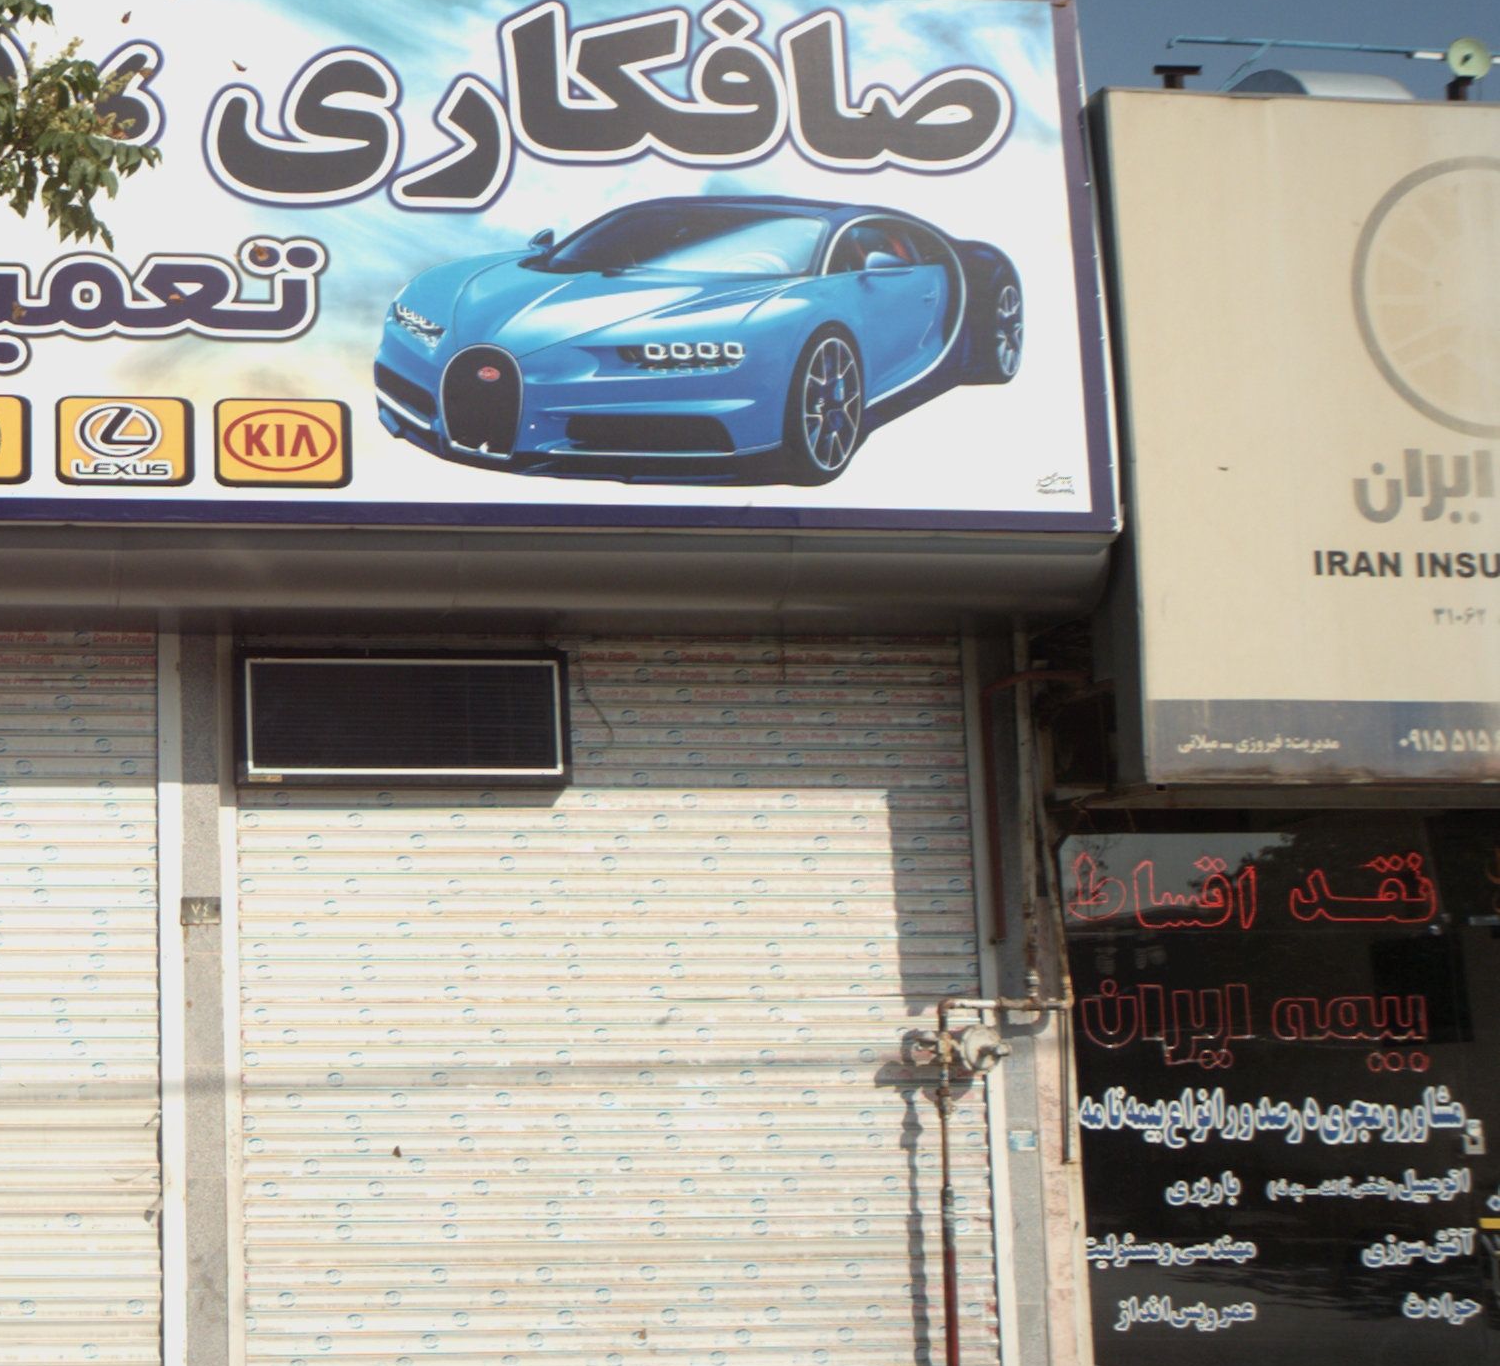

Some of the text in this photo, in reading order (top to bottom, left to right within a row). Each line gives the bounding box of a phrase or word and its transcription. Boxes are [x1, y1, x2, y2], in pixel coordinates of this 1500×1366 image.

[243, 422, 320, 458] KIA
[74, 462, 170, 477] LEXUS
[1352, 448, 1495, 524] ایران
[1313, 550, 1403, 577] IRAN
[1290, 851, 1438, 923] نقد
[1081, 978, 1431, 1072] بیمه ایران
[1164, 1170, 1242, 1207] باربری
[1402, 1291, 1483, 1326] حوادث
